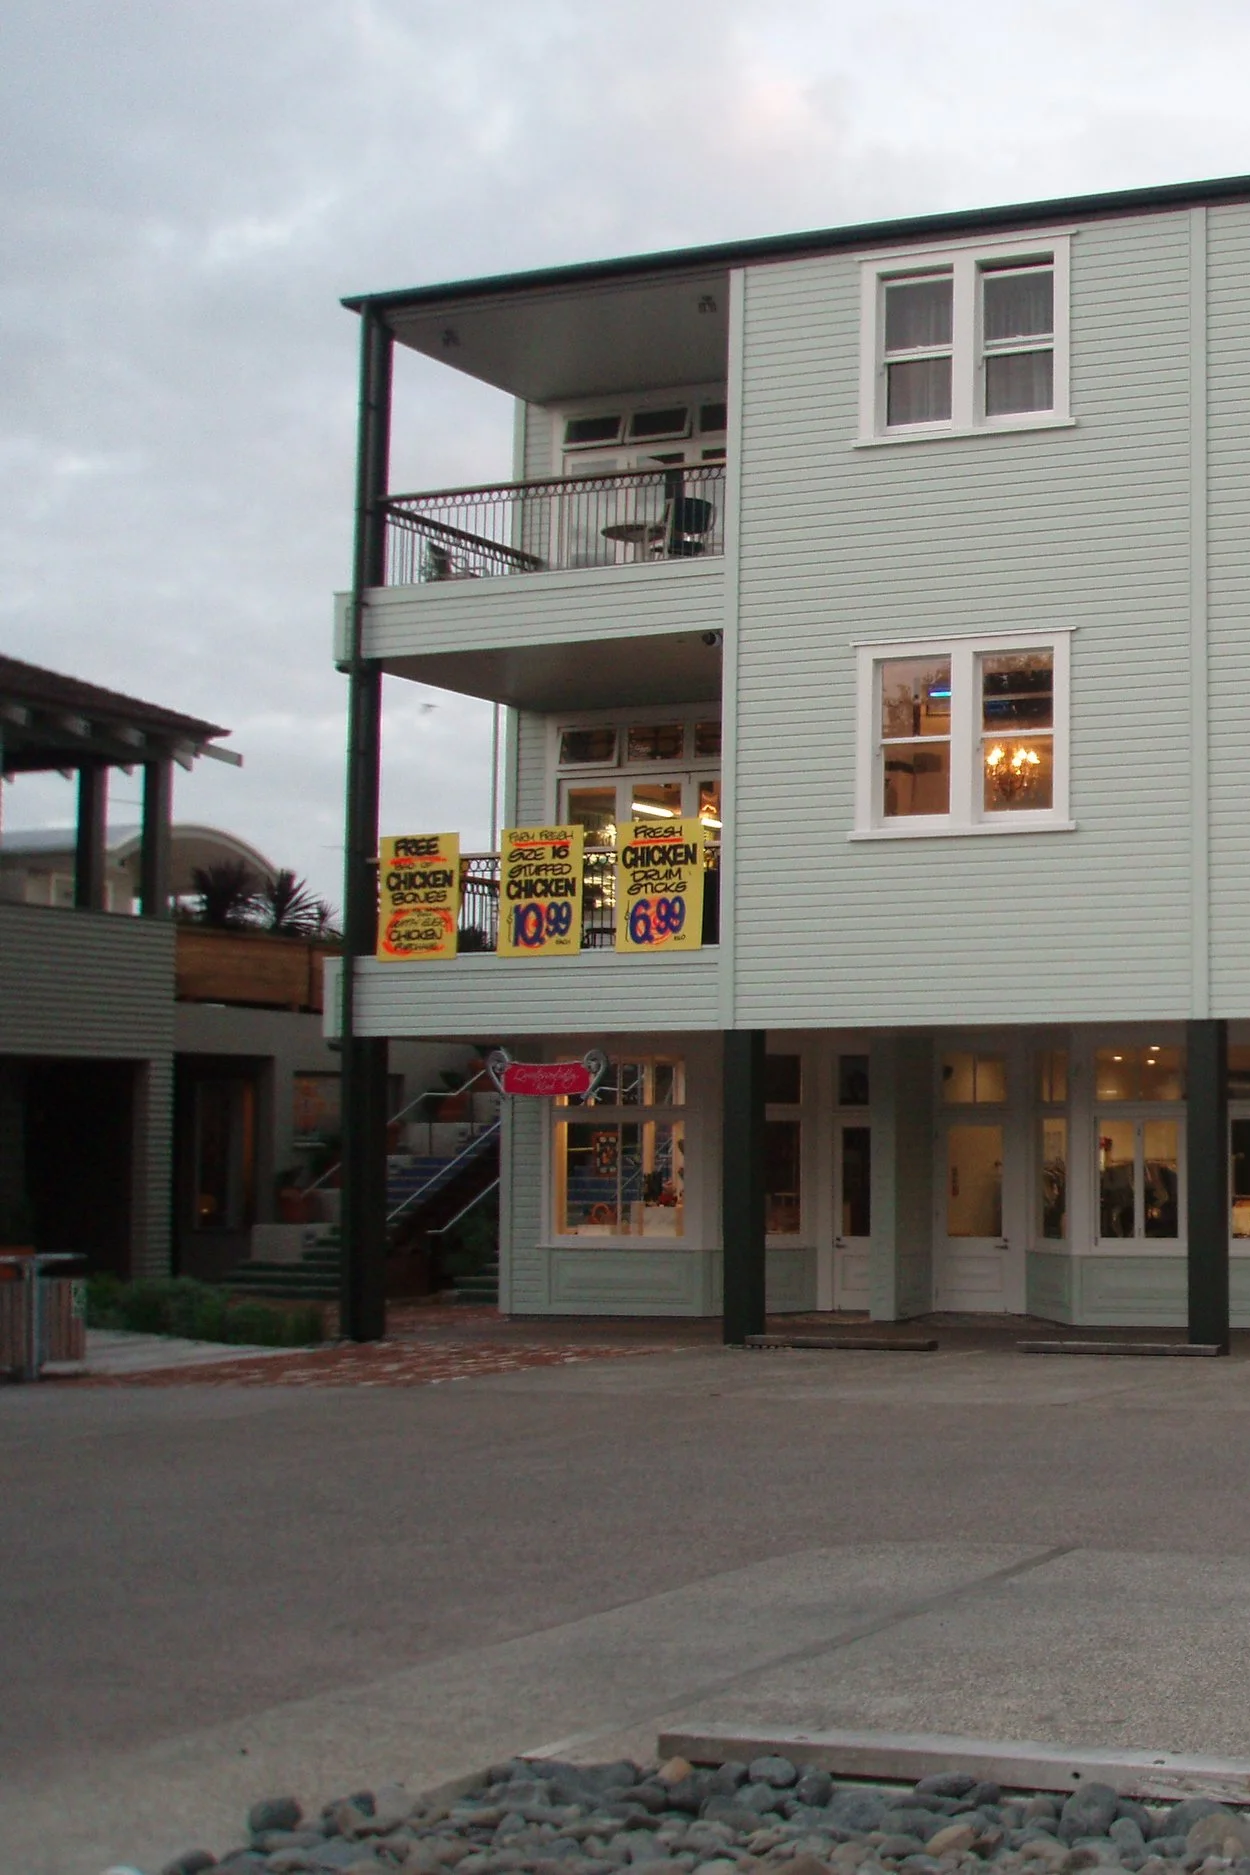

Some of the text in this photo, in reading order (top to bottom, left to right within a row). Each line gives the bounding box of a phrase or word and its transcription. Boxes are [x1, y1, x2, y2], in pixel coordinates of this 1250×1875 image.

[540, 829, 574, 841] FRESH
[633, 825, 683, 839] FRESH
[395, 836, 439, 857] FREE
[507, 845, 569, 862] SIZE 16
[622, 843, 697, 869] CHICKEN
[508, 863, 572, 878] STUFFED
[630, 867, 682, 882] DRUM
[386, 869, 453, 891] CHICKEN
[506, 877, 576, 900] CHICKEN
[627, 881, 688, 895] STICKS
[392, 890, 447, 905] BONES
[389, 928, 443, 942] CHICKEN
